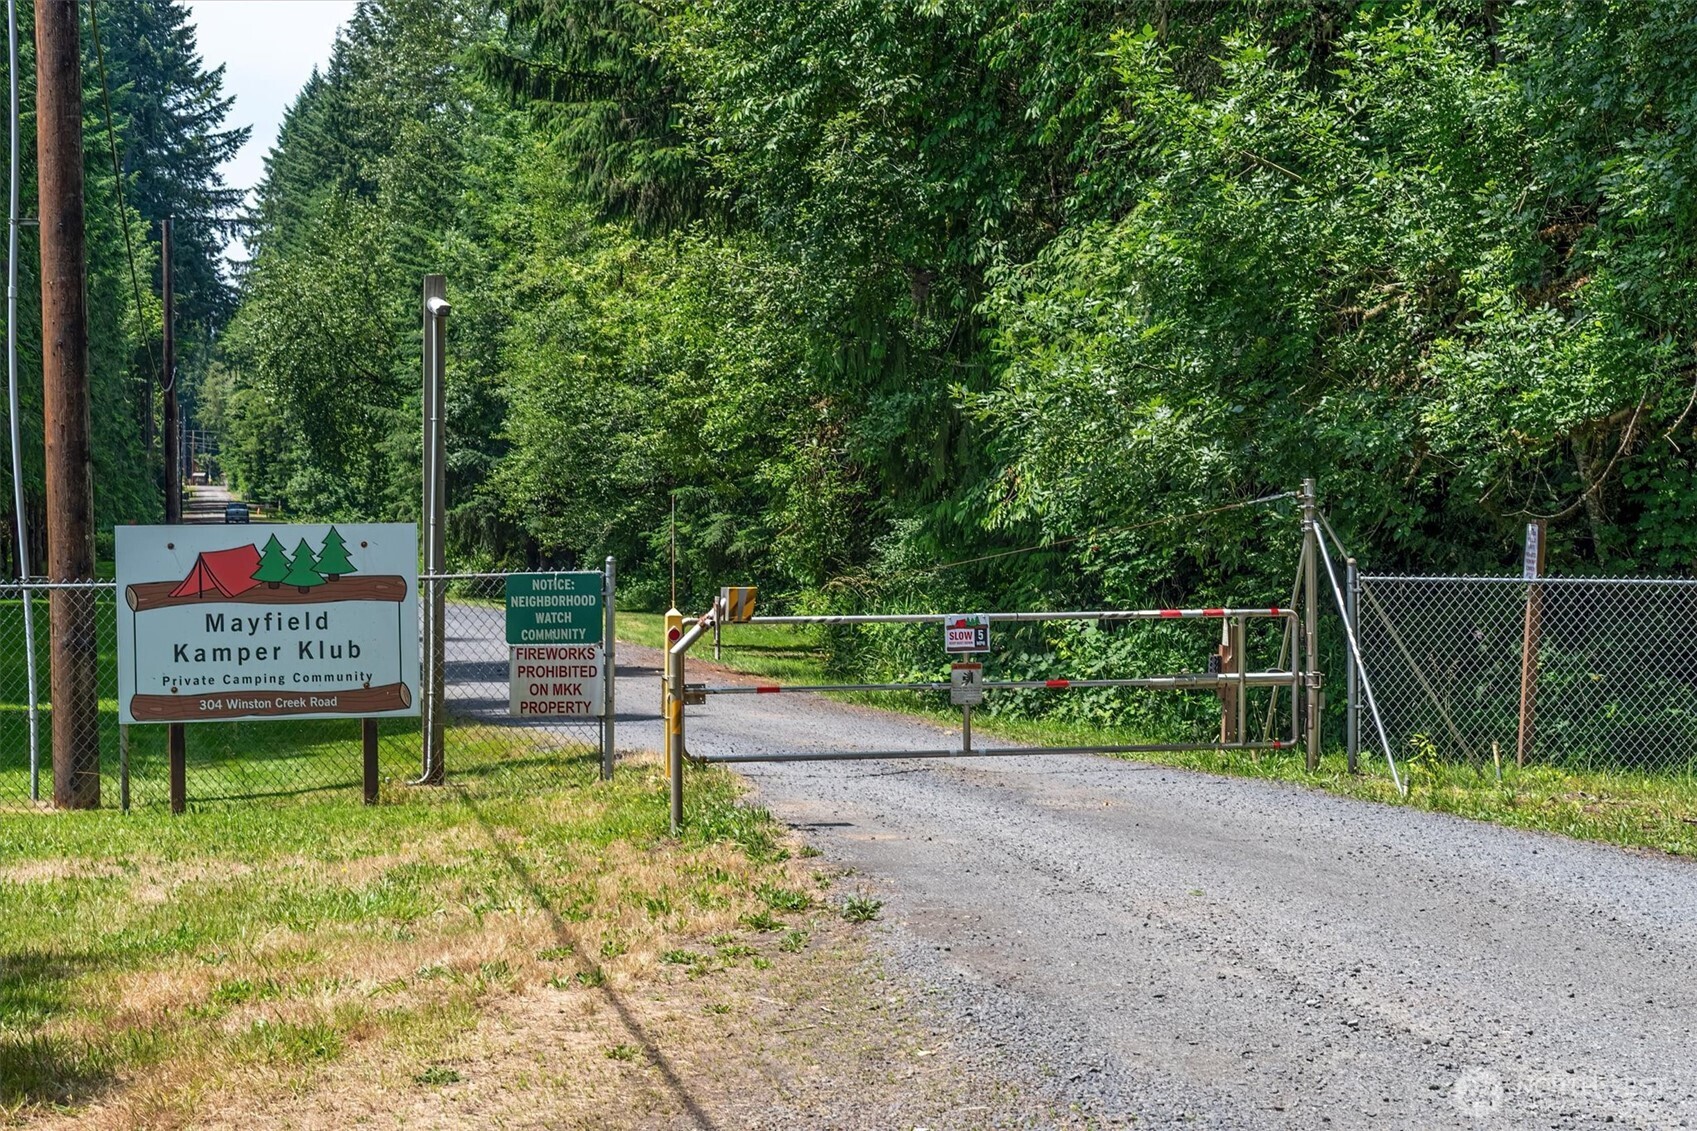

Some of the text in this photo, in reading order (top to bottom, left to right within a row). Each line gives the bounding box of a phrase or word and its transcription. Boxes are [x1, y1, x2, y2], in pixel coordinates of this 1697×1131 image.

[532, 579, 575, 590] NOTICE:
[511, 595, 596, 608] NEIGHBORHOOD
[205, 611, 329, 635] Mayfield
[535, 612, 572, 623] WATCH
[521, 628, 586, 641] COMMUNITY
[949, 631, 973, 640] SLOW
[977, 629, 984, 640] 5
[173, 640, 361, 665] Kamper Klub
[516, 648, 596, 660] FIREWORKS
[517, 665, 598, 678] PROHIBITED
[162, 671, 373, 687] Private Camping Community
[529, 683, 582, 696] ON MKK
[199, 696, 337, 711] 304 Winston Creek Road
[520, 701, 592, 714] PROPERTY
